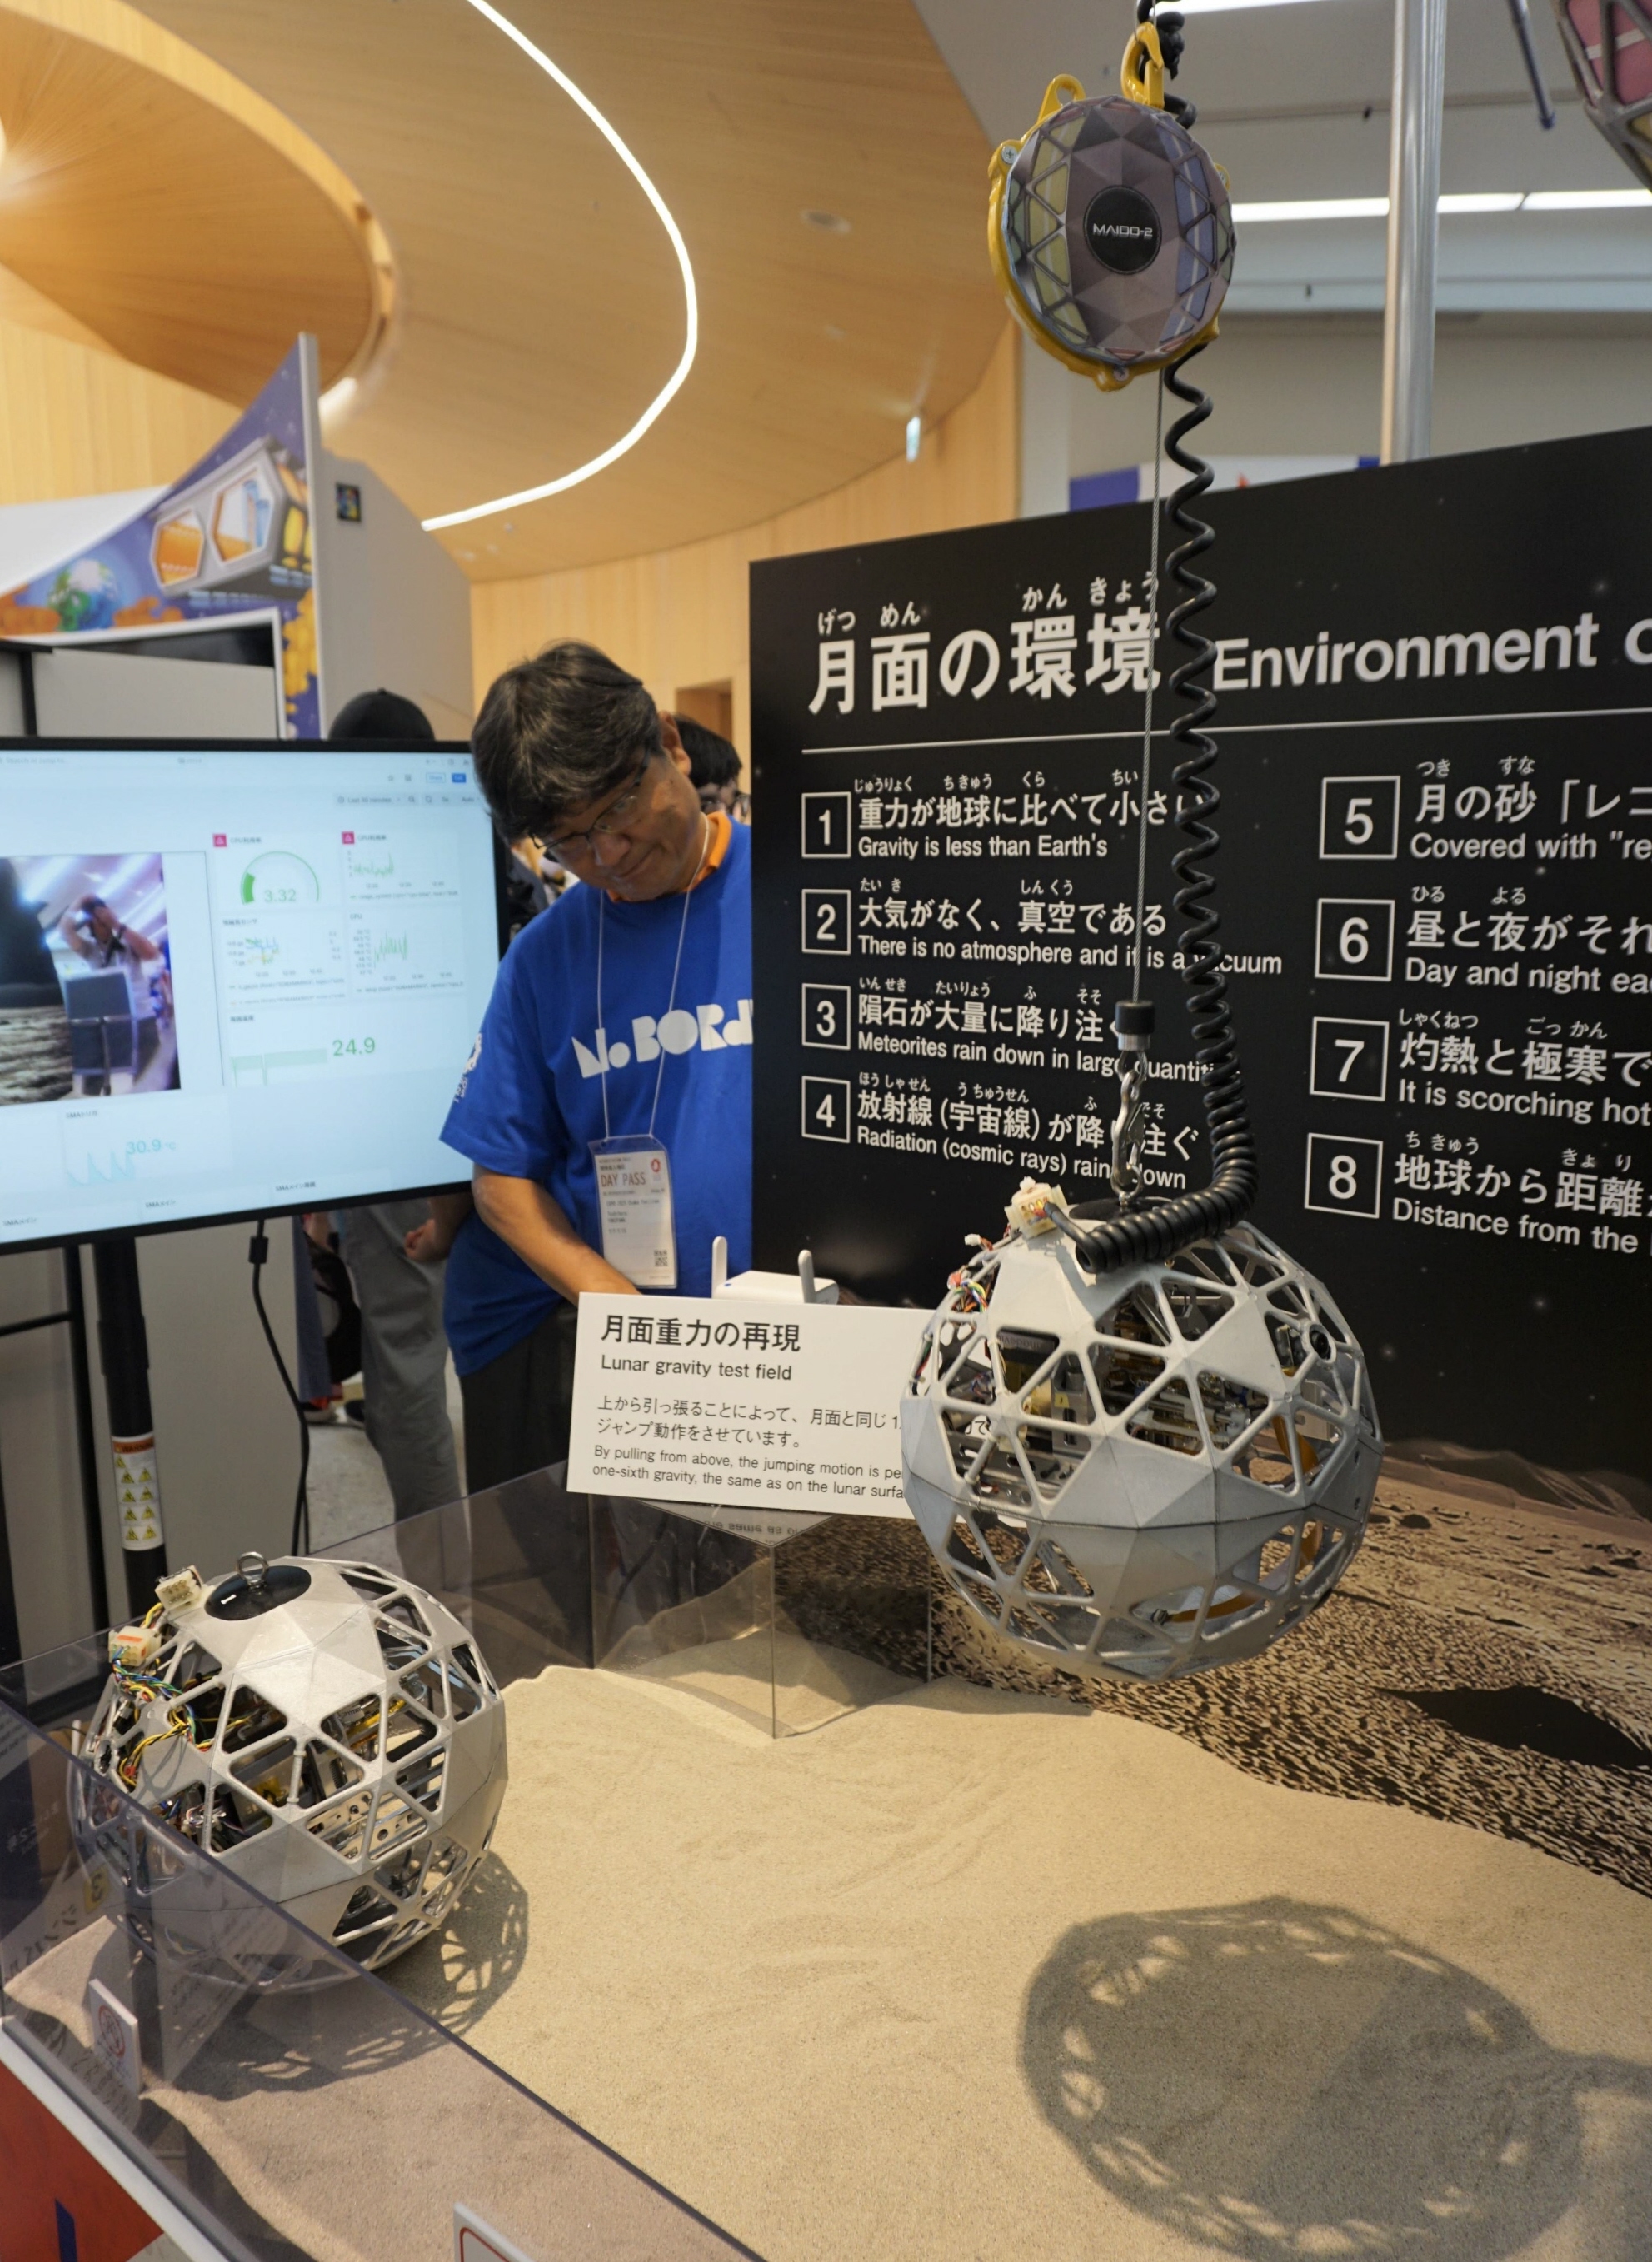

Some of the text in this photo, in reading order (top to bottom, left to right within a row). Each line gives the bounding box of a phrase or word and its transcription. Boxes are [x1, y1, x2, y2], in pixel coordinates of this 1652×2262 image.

[1092, 222, 1154, 237] MAIDO-2
[818, 572, 1159, 634] げつ めん かん きょう
[808, 605, 1162, 715] 月面の環境
[1213, 612, 1599, 692] Environment
[855, 776, 911, 792] じゅうりょく
[1023, 771, 1045, 787] くら
[1112, 769, 1138, 786] ちい
[1418, 756, 1535, 777] つき すな
[819, 810, 830, 845] 1
[1345, 799, 1373, 844] 5
[859, 833, 1107, 860] Gravity is less than Earth's
[1410, 831, 1652, 859] Covered with "re
[264, 890, 297, 902] 3.32
[1412, 886, 1525, 905] ひる よる
[817, 904, 836, 940] 2
[1340, 917, 1368, 963] 6
[1407, 911, 1652, 954] 昼と夜がそれ
[858, 935, 906, 956] There
[913, 937, 926, 956] is
[934, 942, 955, 958] no
[961, 941, 1072, 965] atmosphere
[1080, 945, 1117, 966] and
[1146, 945, 1165, 969] is
[1172, 951, 1186, 970] a
[1195, 954, 1282, 974] cuum
[936, 981, 990, 997] たいりょう
[1025, 986, 1036, 1000] ふ
[1077, 989, 1101, 1005] そそ
[1406, 957, 1652, 994] Day and night ea
[631, 999, 753, 1062] BORd
[817, 1001, 835, 1036] 3
[858, 993, 1118, 1042] 隕石が大量に降り注
[1400, 1009, 1478, 1029] しゃくねつ
[332, 1037, 377, 1056] 24.9
[859, 1031, 946, 1057] Meteorites
[954, 1041, 986, 1061] rain
[994, 1044, 1044, 1066] down
[1052, 1048, 1069, 1068] in
[1335, 1040, 1364, 1081] 7
[1400, 1031, 1652, 1088] 灼熱と極寒で
[816, 1095, 835, 1127] 4
[1085, 1096, 1097, 1111] ふ
[1400, 1079, 1651, 1126] It is scorching hot
[126, 1139, 162, 1155] 30.9
[858, 1124, 936, 1154] Radiation
[943, 1136, 1015, 1165] (cosmic
[1021, 1152, 1066, 1176] rays)
[1132, 1163, 1186, 1189] own
[601, 1171, 646, 1187] DAY PASS
[1330, 1156, 1356, 1199] 8
[1394, 1153, 1652, 1217] 地球から距離
[1394, 1196, 1638, 1253] Distance from the
[601, 1315, 800, 1351] 月面重力の再現
[602, 1355, 791, 1380] Lunar gravity test field
[597, 1395, 901, 1430] 上から引っ張ることによって、月面と同じ1
[596, 1416, 802, 1450] ジャンプ動作をさせています。
[593, 1466, 648, 1478] one-sixth
[654, 1471, 696, 1484] gravity,
[703, 1472, 722, 1485] the
[728, 1476, 761, 1487] same
[766, 1480, 781, 1489] as
[787, 1481, 802, 1490] on
[808, 1481, 827, 1492] the
[834, 1482, 866, 1495] lunar
[595, 1445, 903, 1481] By pulling from above, the jumping motion is pe
